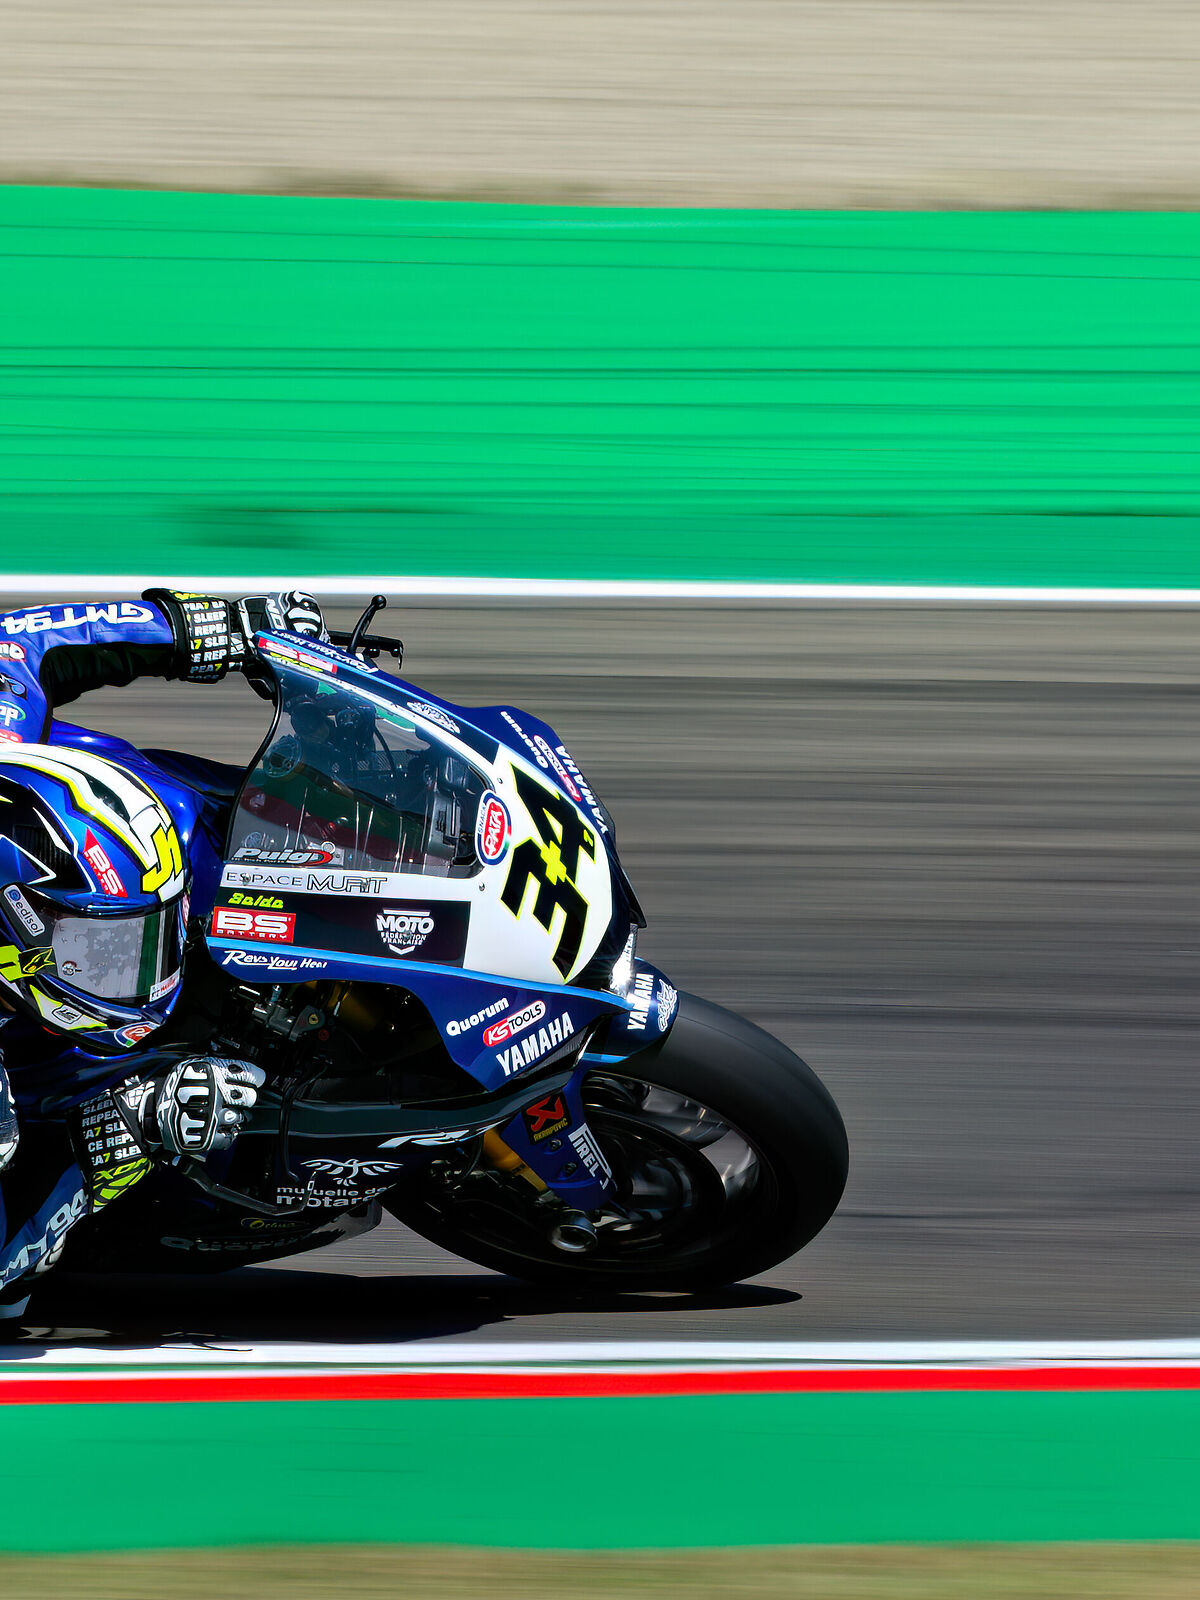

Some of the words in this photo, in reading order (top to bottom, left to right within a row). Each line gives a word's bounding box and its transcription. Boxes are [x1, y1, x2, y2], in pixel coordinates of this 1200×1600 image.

[1, 602, 154, 635] GMT94
[193, 610, 227, 624] SLEEP
[555, 745, 608, 834] YAMAHA
[483, 805, 505, 857] PATA
[233, 848, 319, 865] Puig
[500, 761, 596, 985] 34
[226, 872, 303, 887] ESPACE
[14, 900, 44, 936] edisol
[216, 910, 288, 934] BS
[376, 914, 435, 934] MOTO
[221, 950, 269, 965] Revs
[446, 997, 510, 1036] Quorum
[627, 973, 654, 1031] YAMAHA
[486, 1020, 510, 1045] KS
[508, 1002, 542, 1033] TOOLS
[496, 1012, 575, 1077] YAMAHA
[276, 1186, 359, 1197] muuelle
